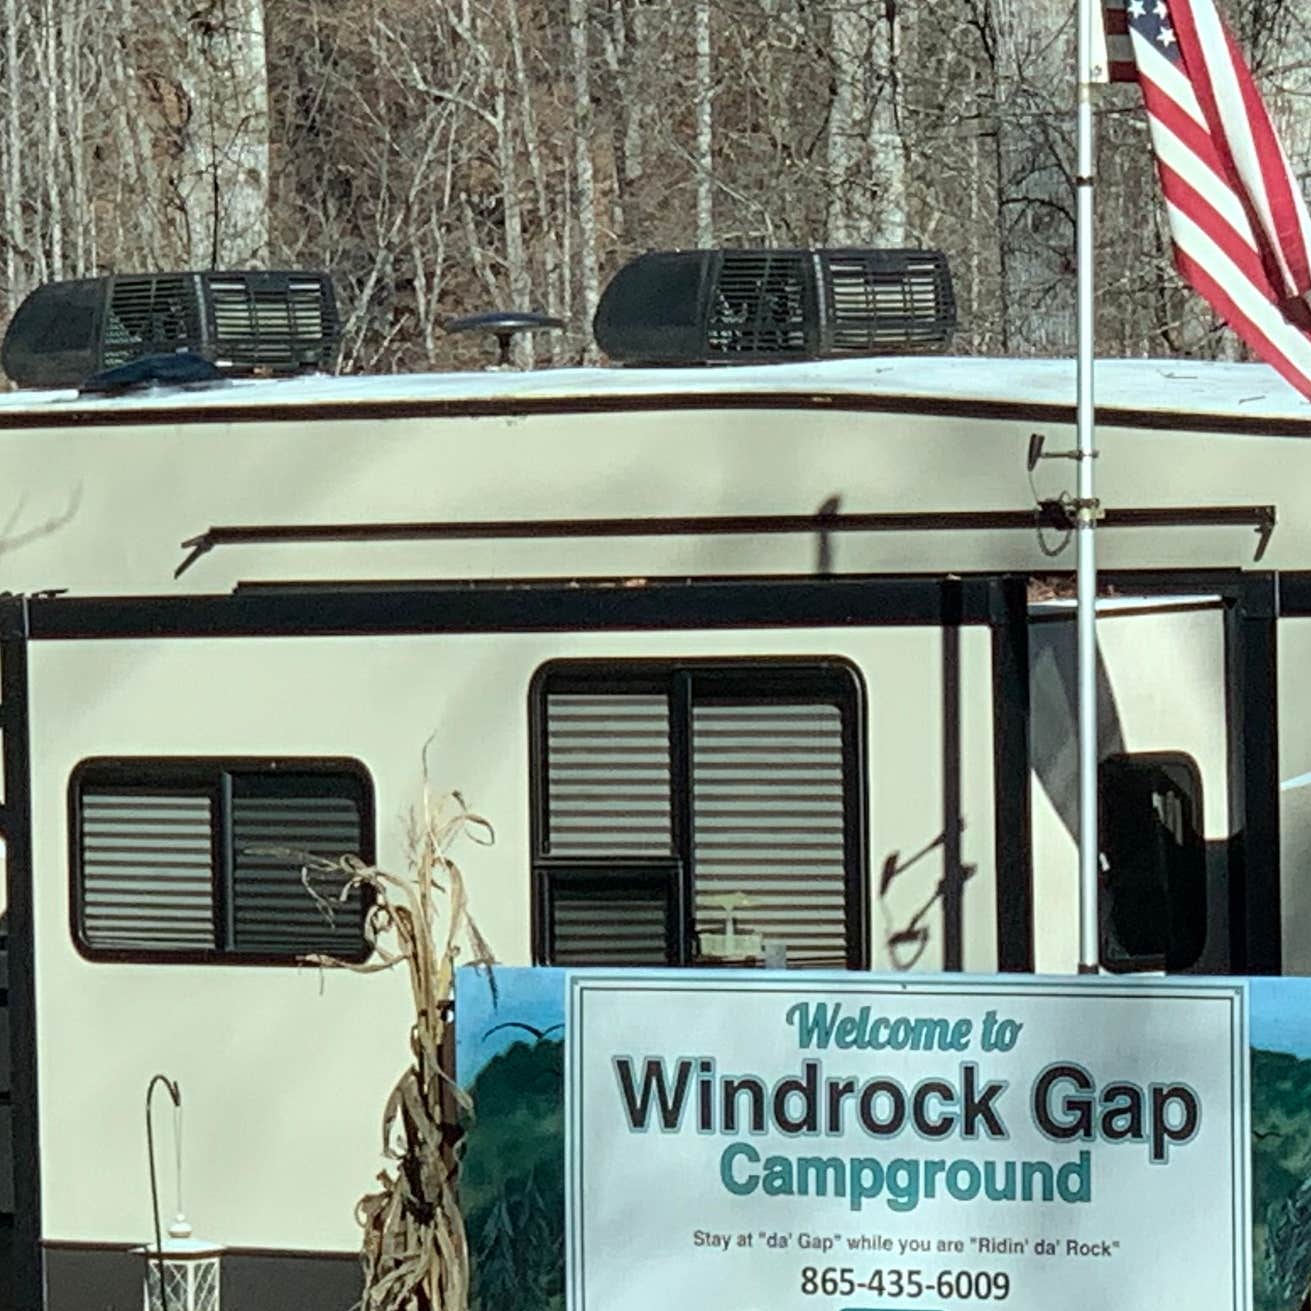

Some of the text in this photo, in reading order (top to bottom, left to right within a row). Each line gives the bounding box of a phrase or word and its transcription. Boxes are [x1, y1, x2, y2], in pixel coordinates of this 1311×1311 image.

[786, 1002, 1024, 1052] Welcome to
[612, 1055, 1201, 1164] Windrock Gap
[720, 1142, 1091, 1212] Campground
[694, 1230, 731, 1251] Stay
[737, 1233, 753, 1247] at
[798, 1232, 841, 1253] Gap"
[847, 1235, 893, 1250] while
[899, 1238, 931, 1255] you
[937, 1239, 964, 1252] are
[1034, 1238, 1060, 1256] da'
[1066, 1239, 1120, 1257] Rock"
[801, 1266, 1010, 1300] 865-435-6009
